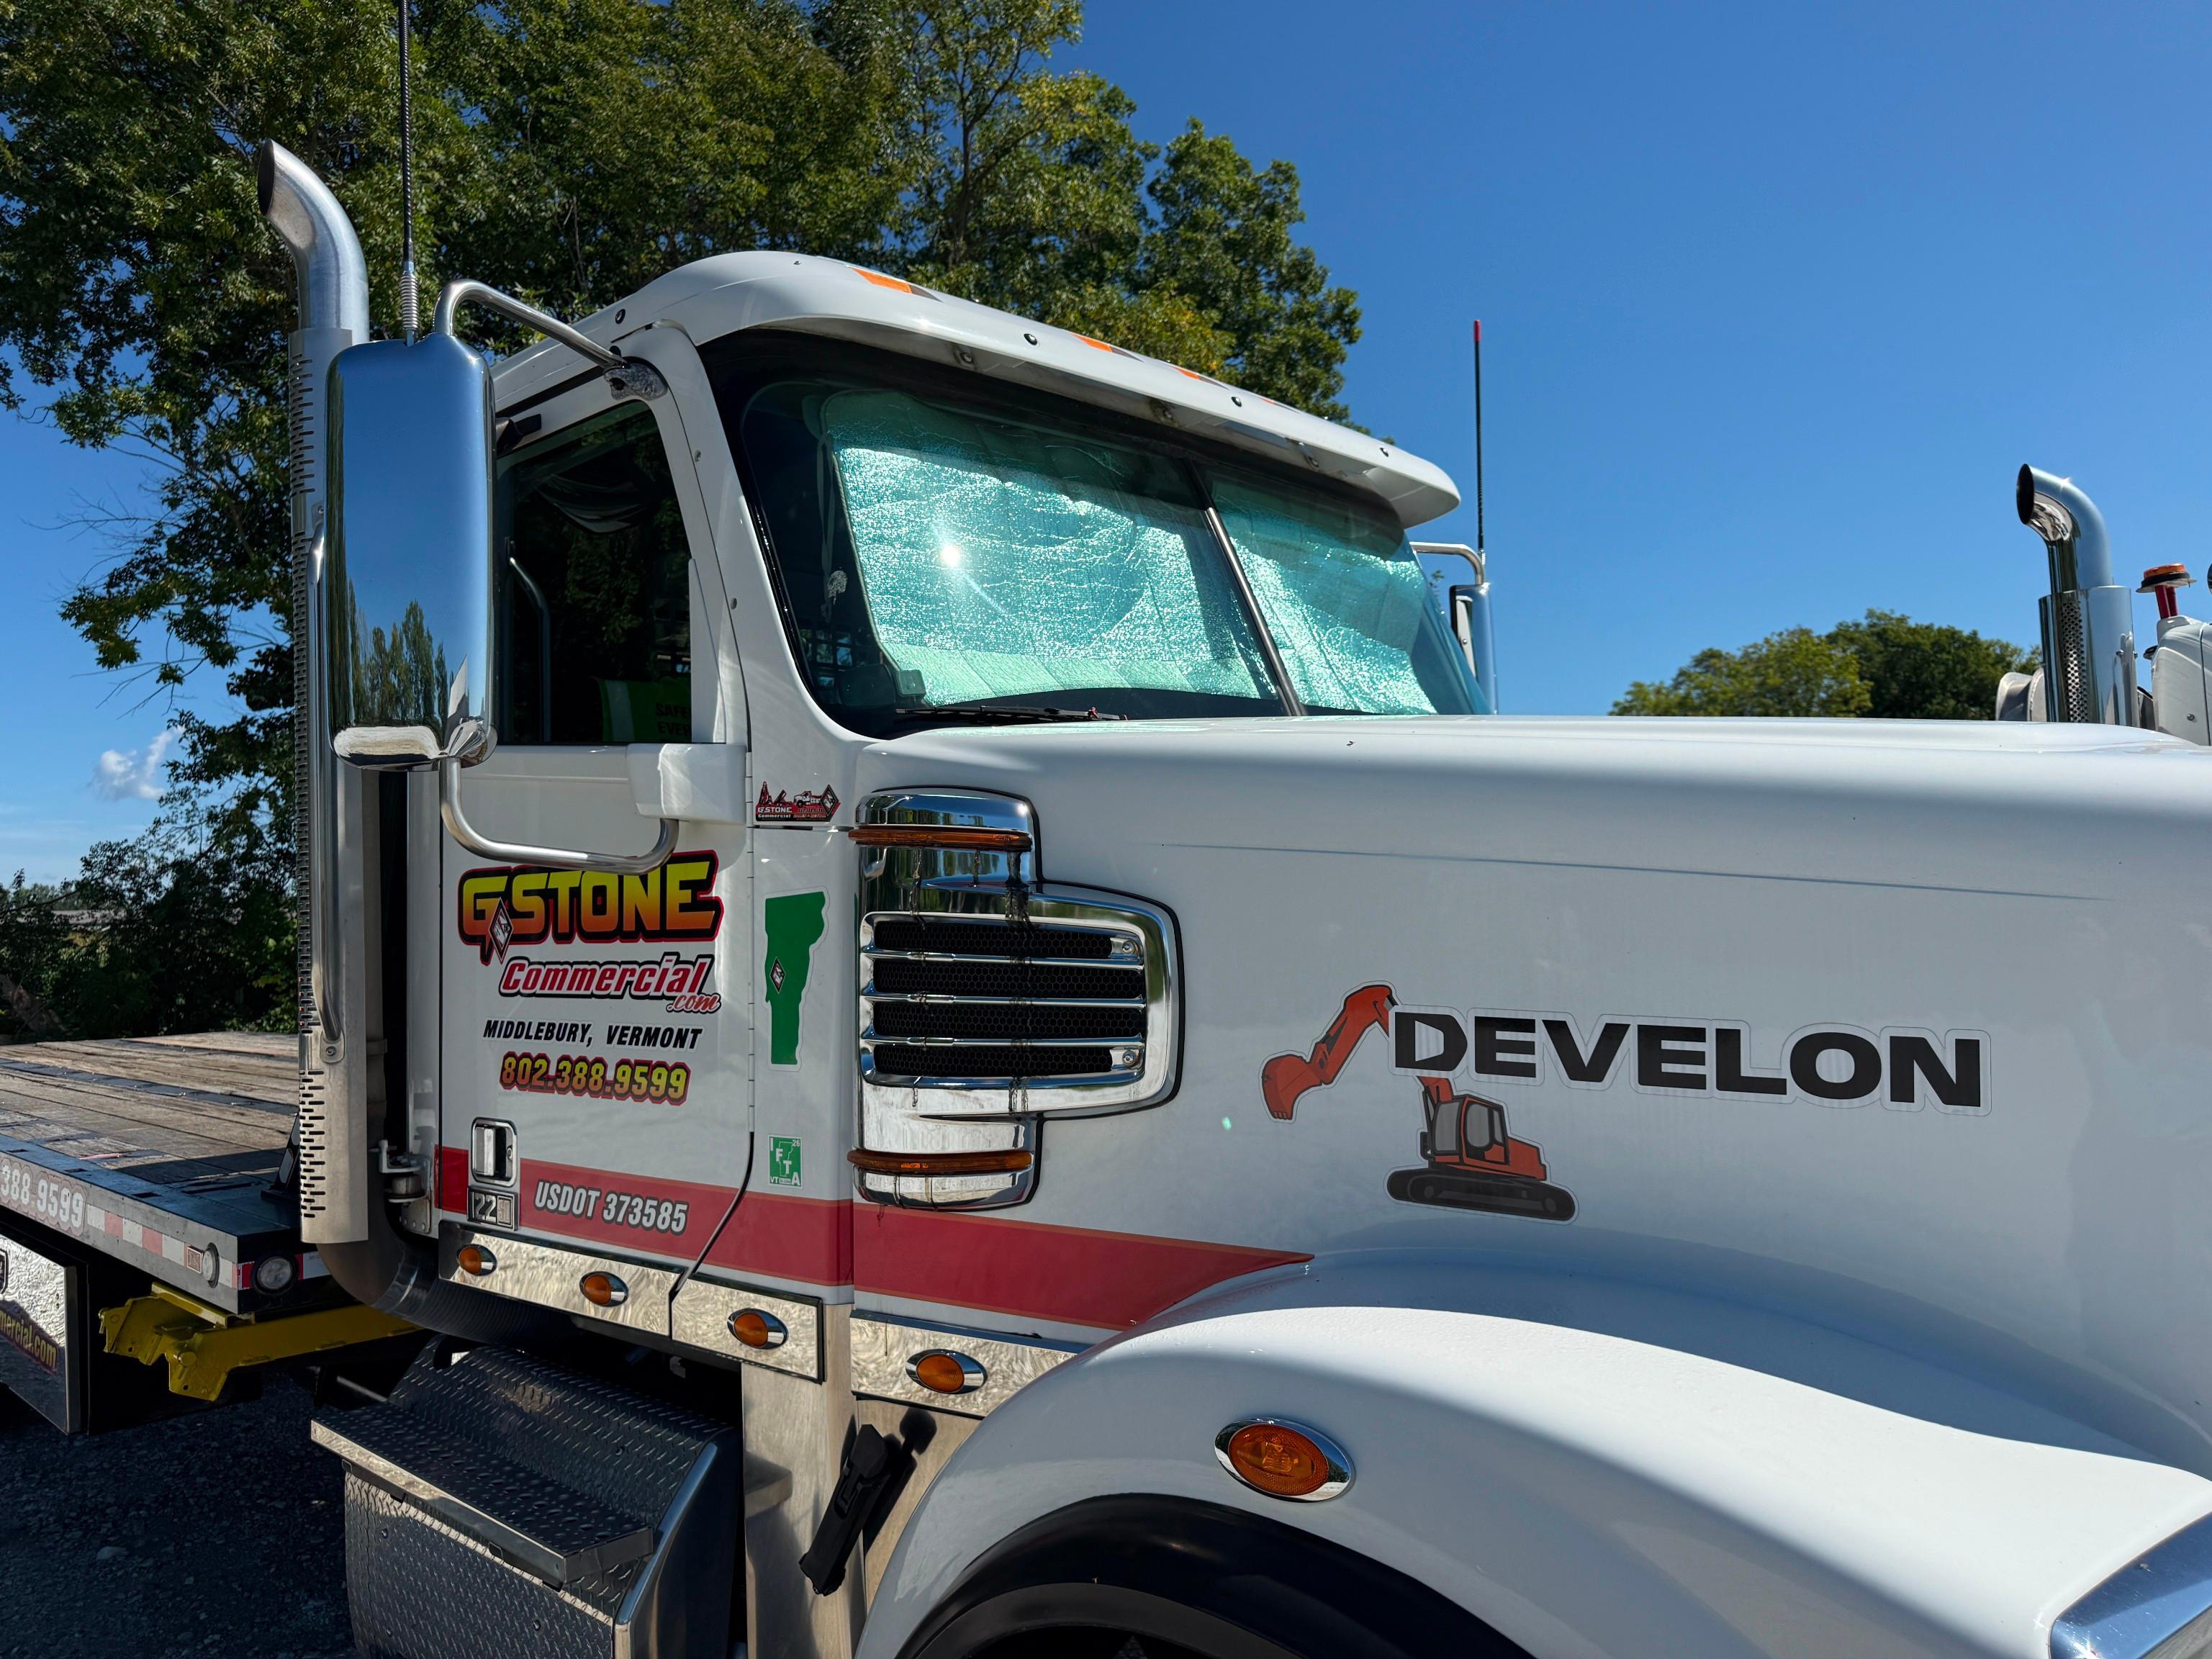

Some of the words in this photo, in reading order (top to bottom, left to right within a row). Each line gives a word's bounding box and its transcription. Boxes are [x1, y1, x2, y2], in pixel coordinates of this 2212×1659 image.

[500, 954, 713, 996] Commercial
[483, 1019, 592, 1047] MIDDLEBURY,
[606, 1025, 703, 1049] VERMONT
[501, 1054, 689, 1103] 802.388.9599
[1394, 1011, 1981, 1108] DEVELON
[535, 1180, 600, 1218] USDOT
[603, 1193, 689, 1233] 373585
